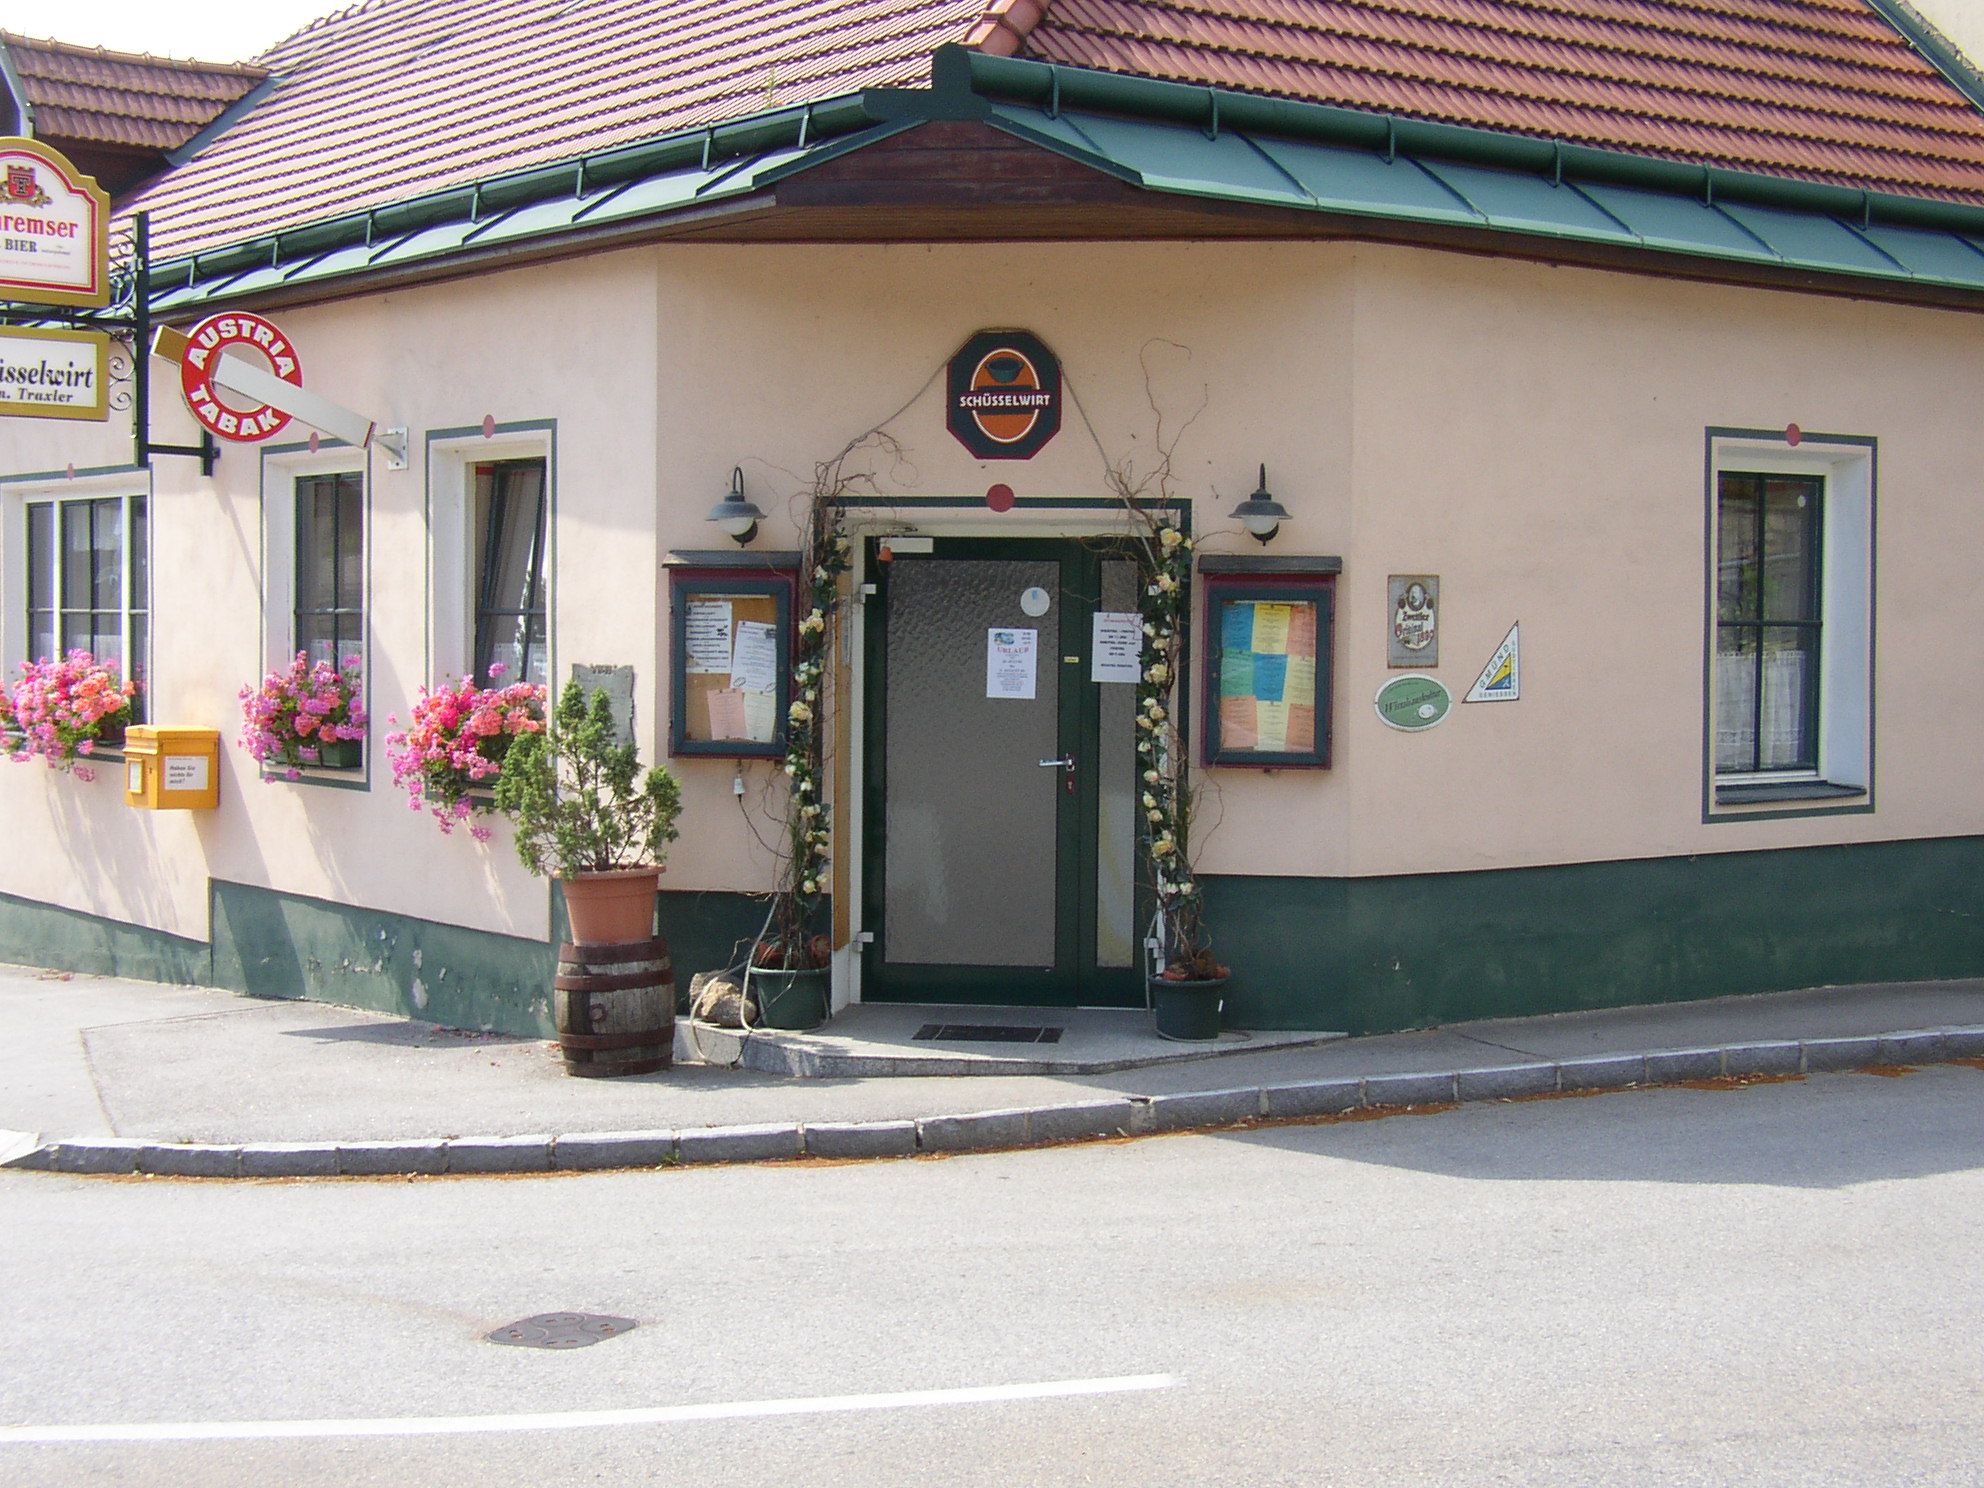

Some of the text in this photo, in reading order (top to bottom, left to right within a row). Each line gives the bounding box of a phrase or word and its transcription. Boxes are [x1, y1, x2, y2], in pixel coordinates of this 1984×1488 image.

[5, 239, 37, 253] BIER
[188, 318, 297, 378] AUSTRIA
[19, 387, 73, 403] Traxler
[959, 392, 1051, 408] SCHÜSSELWIRT
[190, 385, 281, 437] TABAK
